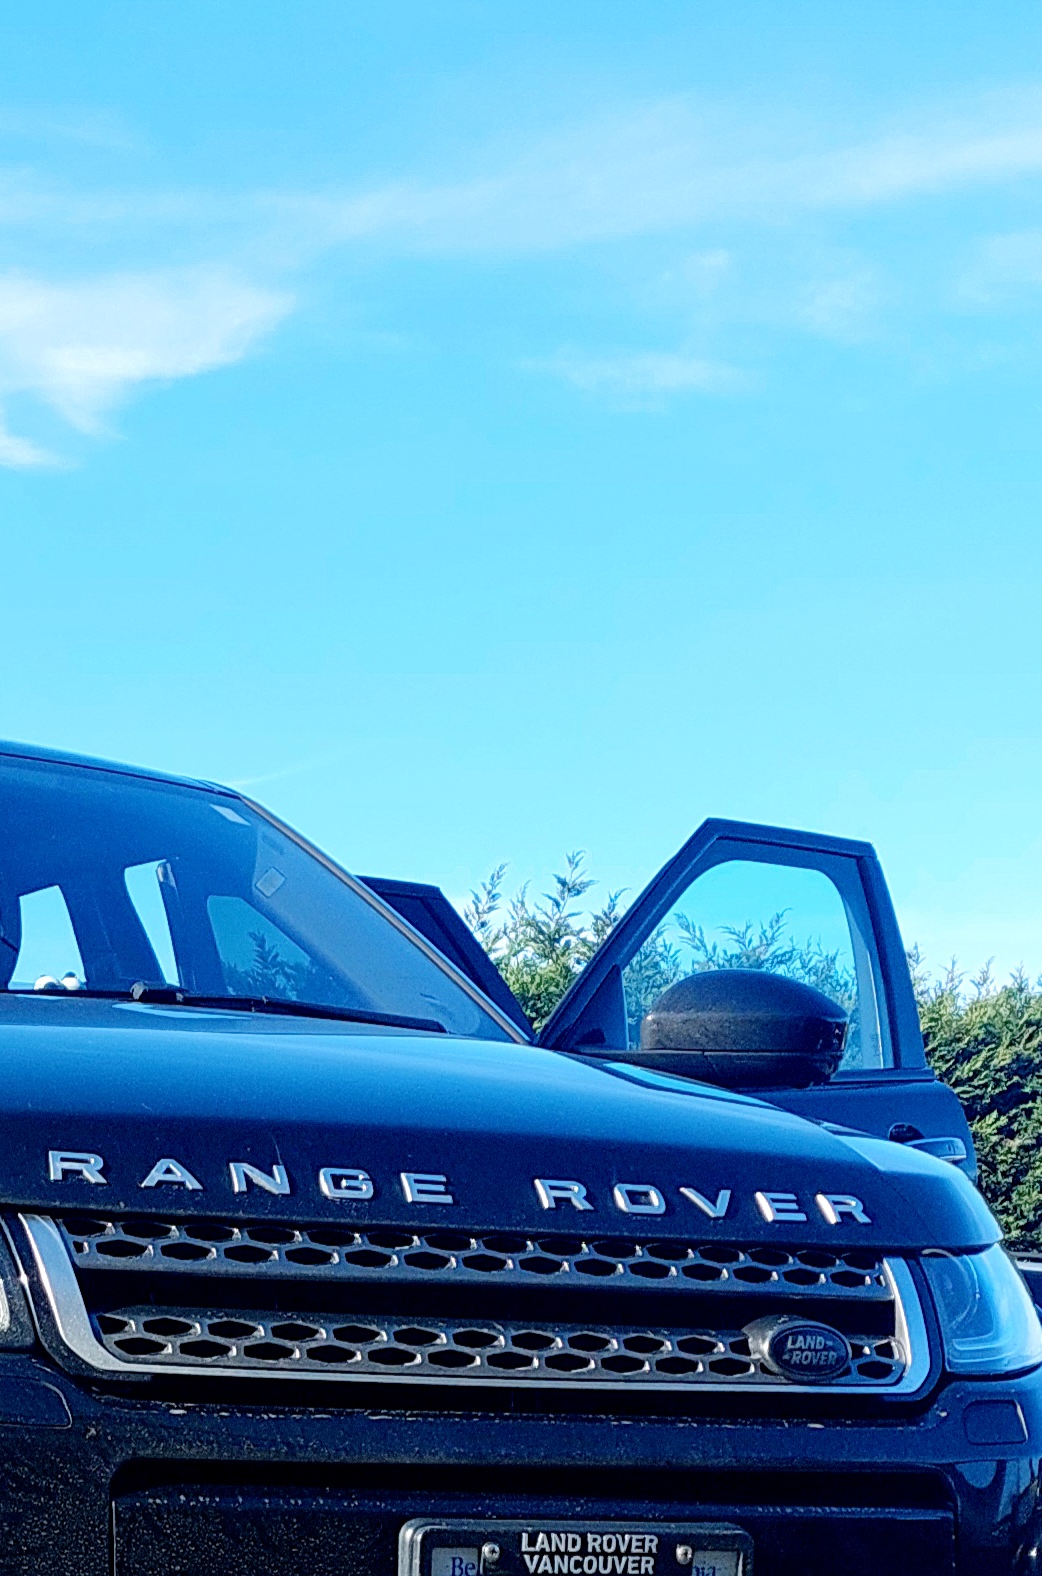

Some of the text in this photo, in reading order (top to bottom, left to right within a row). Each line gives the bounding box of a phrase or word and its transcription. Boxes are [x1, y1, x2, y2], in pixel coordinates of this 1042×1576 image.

[47, 1150, 872, 1225] RANGE ROVER
[521, 1532, 658, 1554] LAND ROVER
[524, 1555, 655, 1575] VANCOUVER
